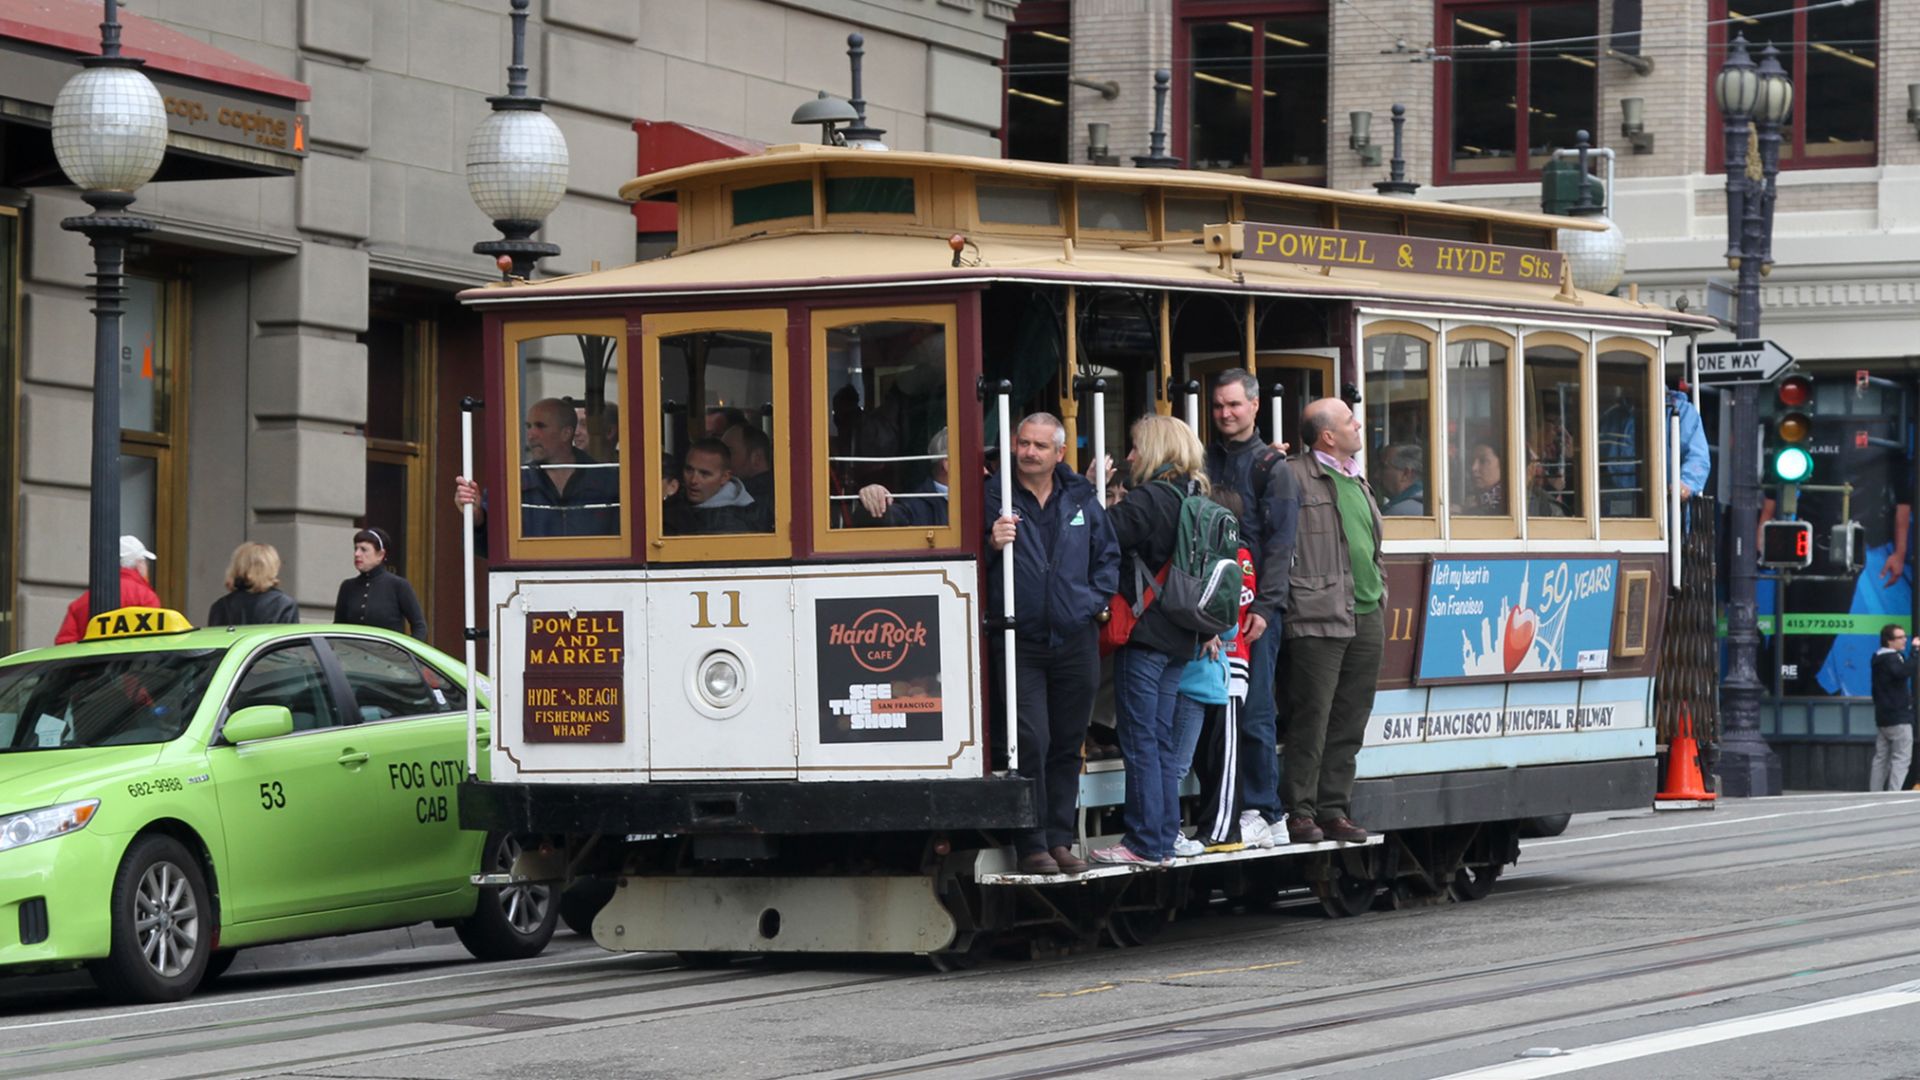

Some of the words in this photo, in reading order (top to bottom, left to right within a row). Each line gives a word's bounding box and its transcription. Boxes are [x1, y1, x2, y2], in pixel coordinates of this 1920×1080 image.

[218, 106, 287, 137] copine
[1256, 231, 1375, 264] POWELL
[1397, 244, 1413, 268] &
[1436, 247, 1504, 275] HYDE
[1519, 254, 1553, 279] Sts.
[1698, 355, 1726, 371] ONE
[1731, 353, 1760, 369] WAY
[1436, 564, 1449, 585] left
[1450, 571, 1461, 591] my
[1462, 564, 1481, 585] heart
[1482, 566, 1490, 585] in
[1540, 562, 1568, 613] 50
[1574, 564, 1611, 601] YEARS
[690, 590, 749, 628] 11
[1430, 594, 1446, 616] San
[1447, 594, 1484, 616] Francisco
[97, 612, 166, 635] TAXI
[532, 617, 619, 634] POWELL
[829, 622, 879, 645] Hard
[881, 621, 927, 647] Rock
[1388, 608, 1413, 641] 11
[1786, 620, 1855, 629] 415.772.0335
[555, 635, 598, 648] AND
[530, 648, 621, 664] MARKET
[867, 651, 893, 660] CAFE
[528, 688, 558, 706] HYDE
[579, 688, 618, 706] BEACH
[849, 683, 891, 699] SEE
[535, 710, 609, 723] FISHERMANS
[829, 699, 872, 715] THE
[895, 702, 935, 710] FRANCISCO
[553, 724, 592, 737] WHARF
[850, 713, 907, 729] SHOW
[1383, 717, 1412, 740] SAN
[1416, 711, 1491, 735] FRANCISCO
[1496, 708, 1561, 733] MUNICIPAL
[1566, 706, 1615, 729] RAILWAY
[389, 762, 424, 789] FOG
[431, 760, 465, 787] CITY
[128, 777, 183, 798] 682-9988
[260, 781, 286, 810] 53
[416, 797, 448, 823] CAB
